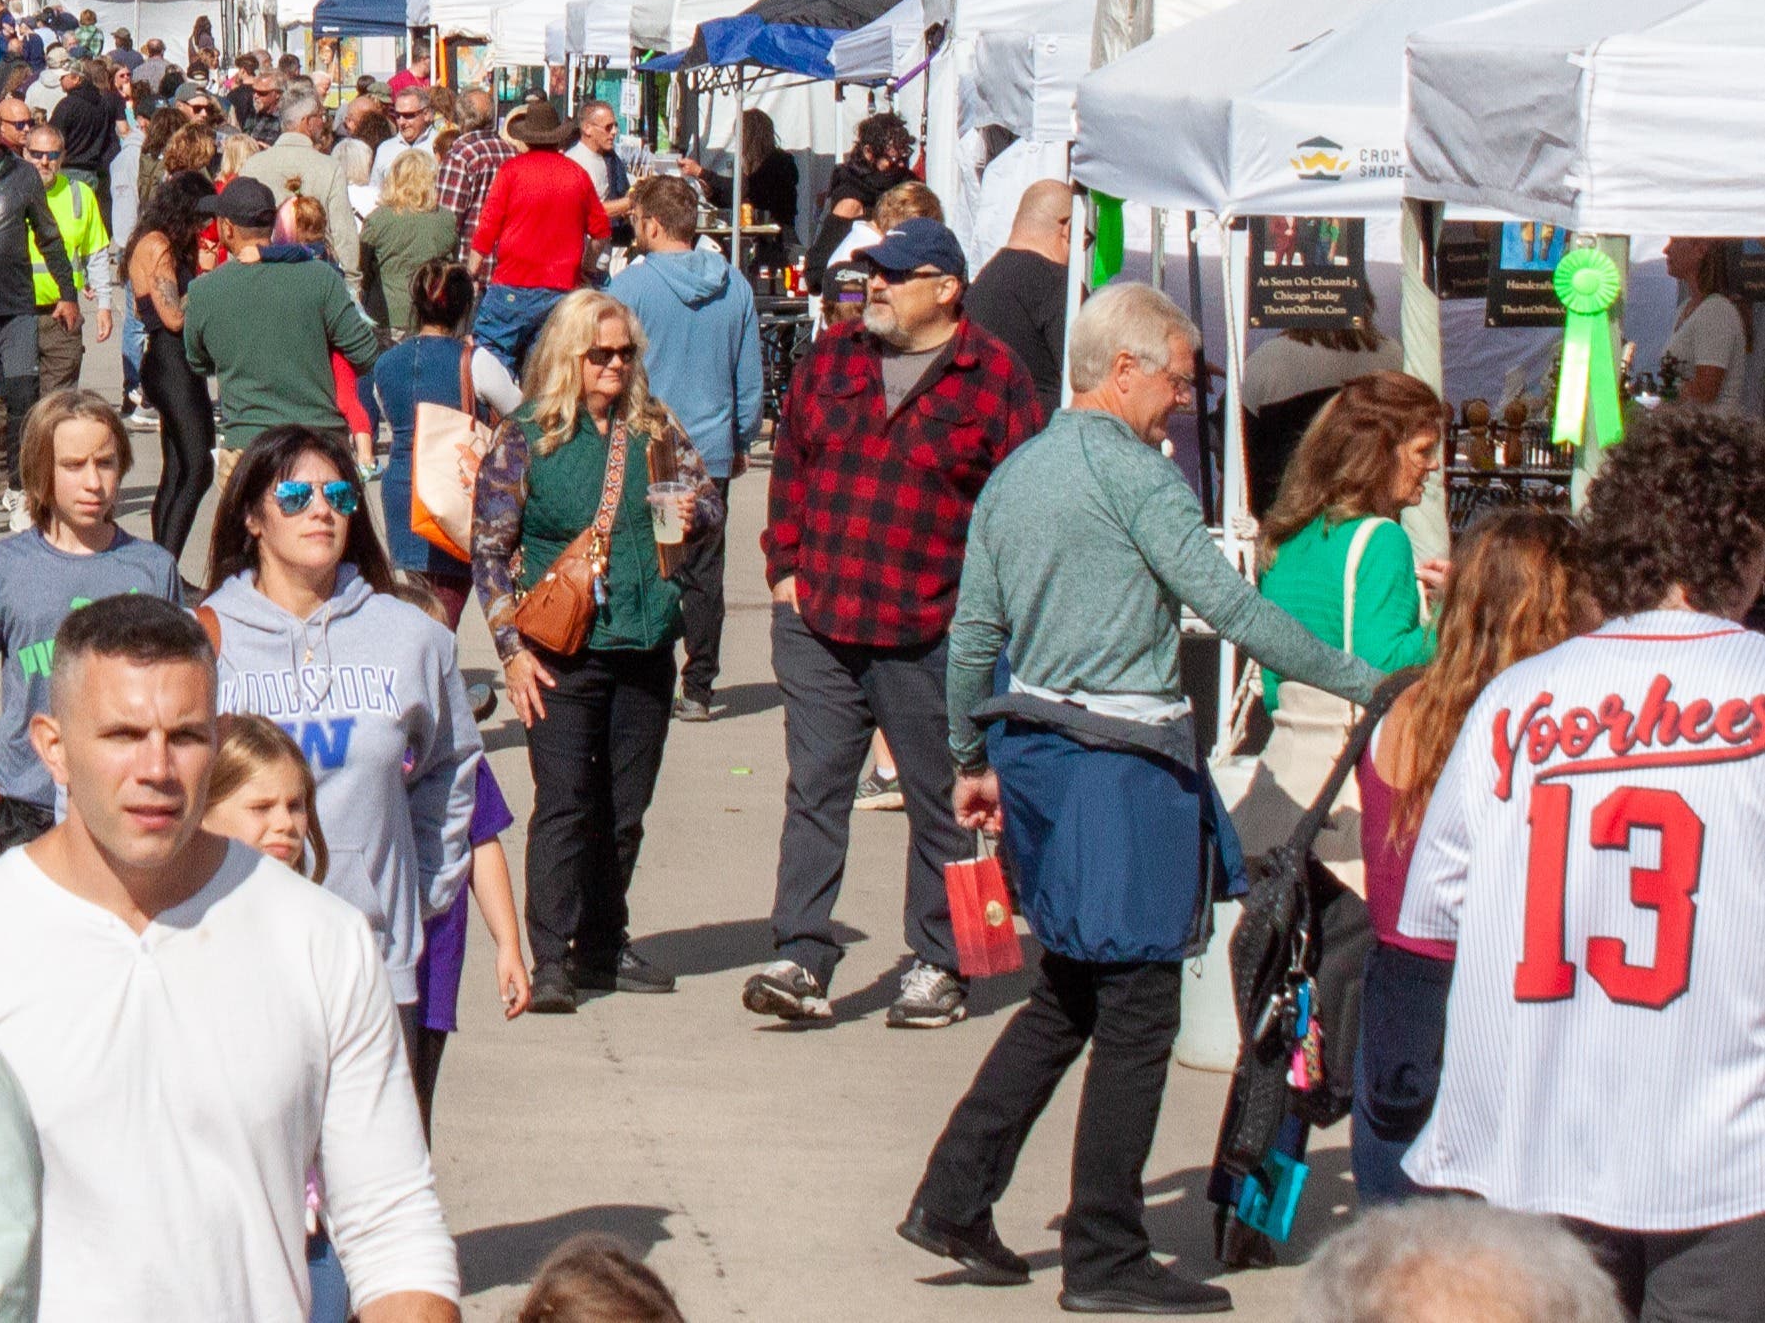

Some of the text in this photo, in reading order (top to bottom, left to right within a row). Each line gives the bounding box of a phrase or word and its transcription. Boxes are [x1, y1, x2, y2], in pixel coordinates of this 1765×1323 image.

[1257, 276, 1269, 287] As
[1270, 276, 1292, 287] Seen
[1294, 276, 1309, 286] On
[1311, 276, 1350, 287] Channel
[1273, 290, 1340, 303] Chicago Today
[220, 661, 404, 719] WOODSTOCK
[1514, 782, 1706, 1012] 13
